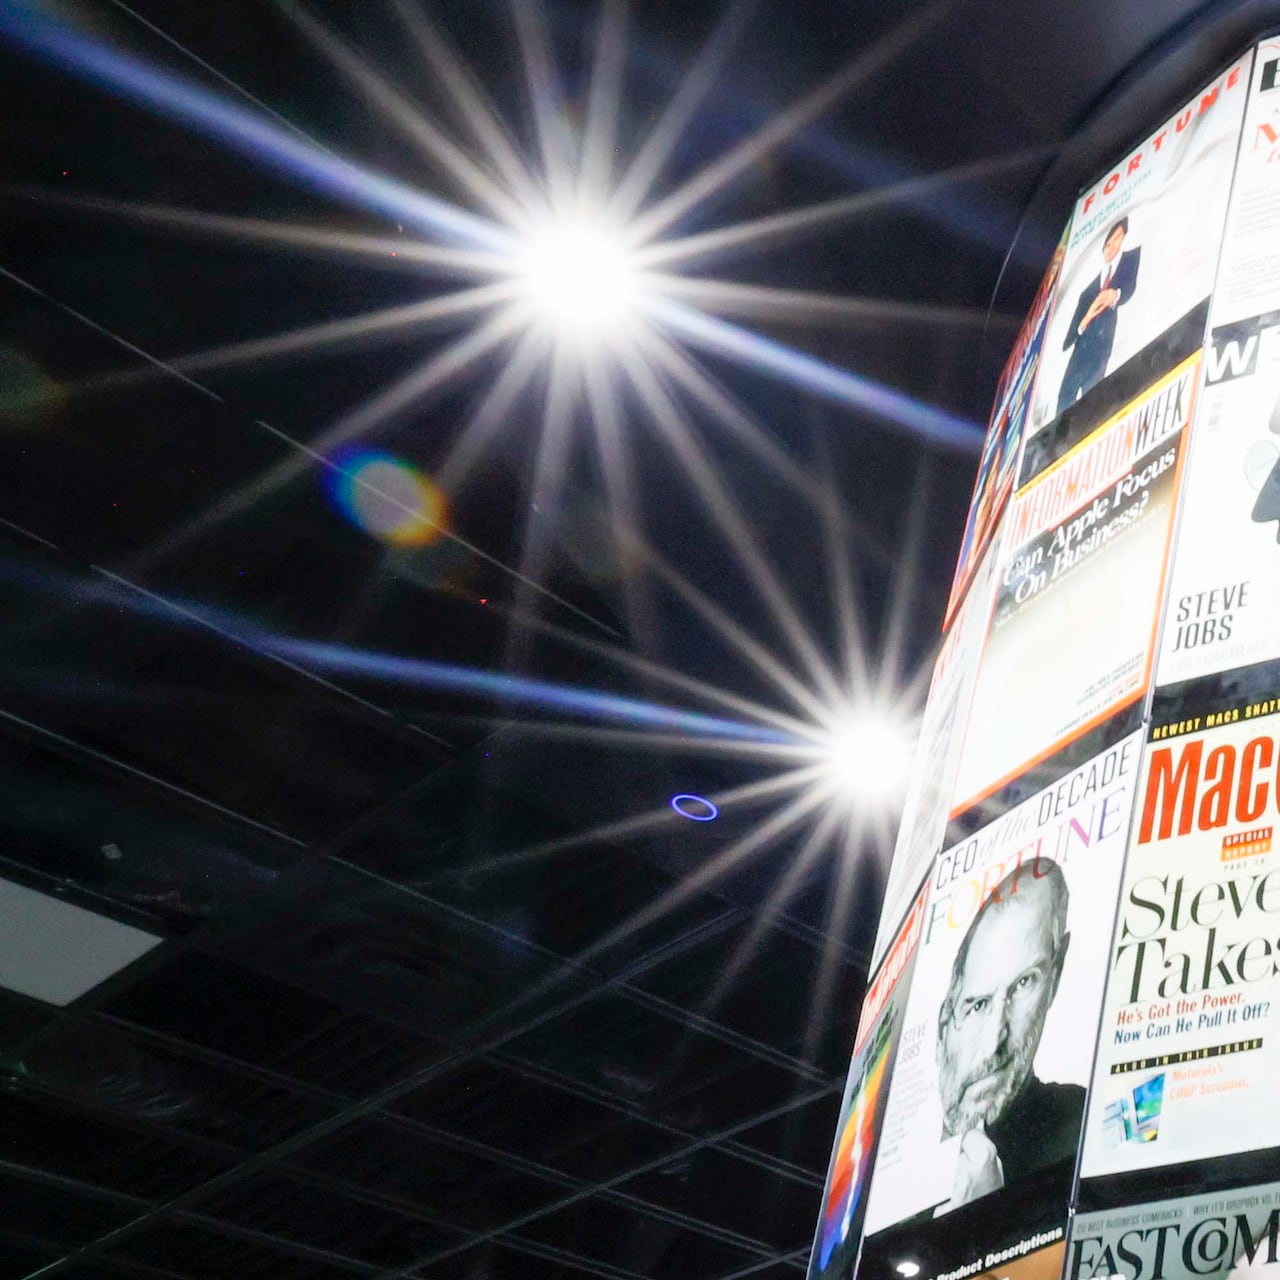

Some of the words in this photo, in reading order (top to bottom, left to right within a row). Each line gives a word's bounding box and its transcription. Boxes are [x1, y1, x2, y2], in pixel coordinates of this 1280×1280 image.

[1083, 67, 1241, 215] FORTUNE
[1177, 581, 1251, 623] STEVE
[1173, 615, 1234, 652] JOBS
[1152, 718, 1201, 739] NEWEST
[1206, 708, 1239, 728] MACS
[935, 847, 978, 892] CEO
[1037, 740, 1134, 826] DECADE
[924, 787, 1127, 947] FORTUNE
[1114, 1025, 1142, 1045] Now
[1146, 1021, 1171, 1039] Can
[1175, 1018, 1193, 1033] He
[1198, 1011, 1223, 1029] Pull
[1227, 1008, 1239, 1026] It
[1242, 1001, 1271, 1021] Off?
[1117, 1007, 1144, 1026] He's
[1148, 1002, 1172, 1021] Got
[1176, 998, 1198, 1016] the
[1202, 992, 1246, 1010] Power.
[985, 1227, 1063, 1268] Descriptions
